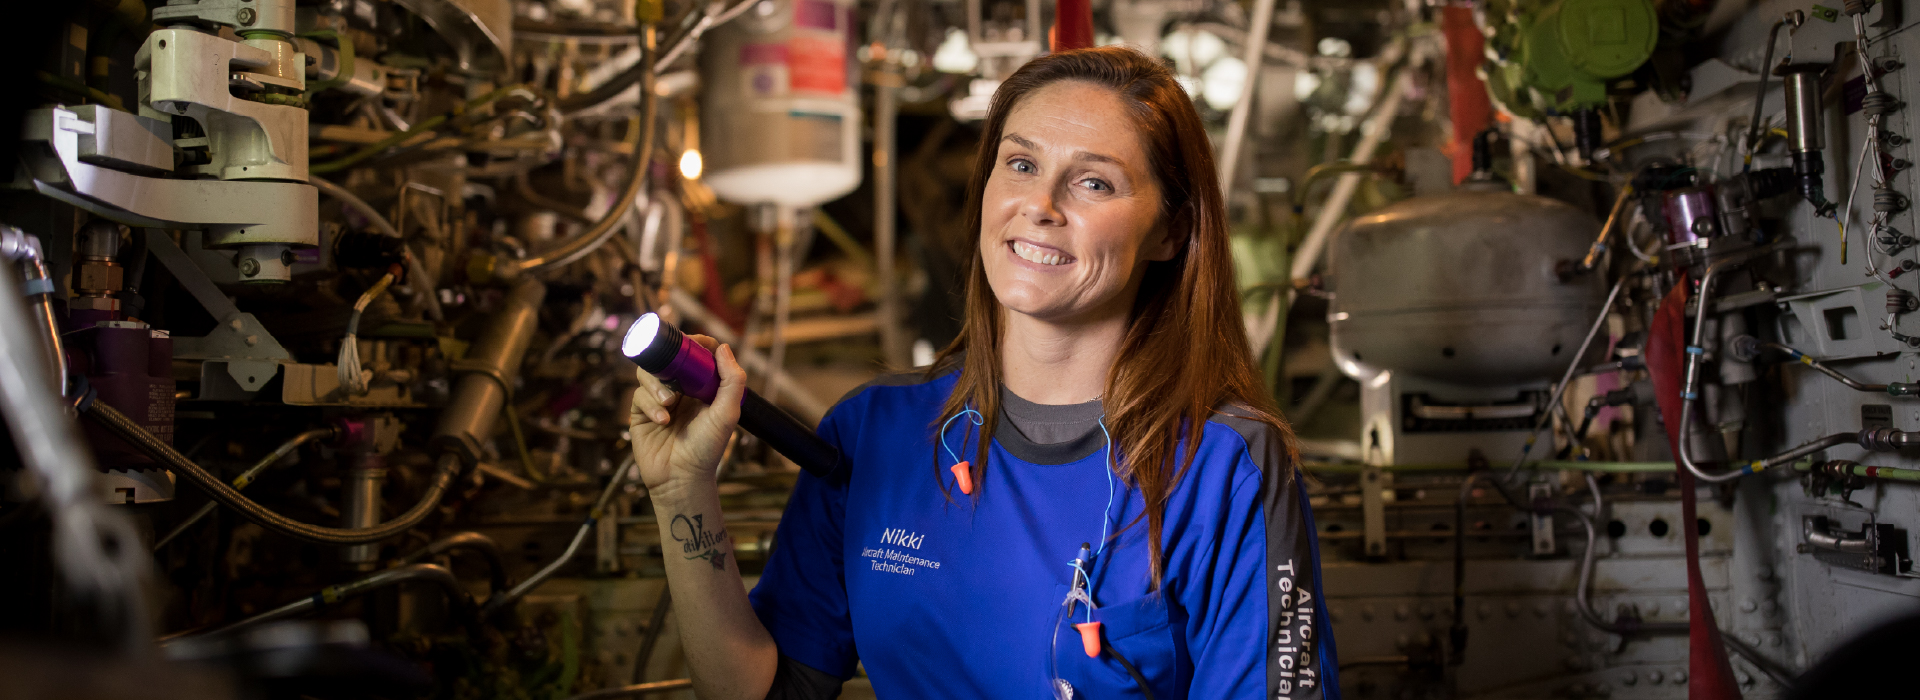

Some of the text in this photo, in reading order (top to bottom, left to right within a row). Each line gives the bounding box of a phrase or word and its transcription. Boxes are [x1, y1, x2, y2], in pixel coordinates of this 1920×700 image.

[880, 527, 925, 550] Nikki
[871, 559, 915, 576] Technician
[884, 548, 941, 570] Maintenance
[1277, 558, 1297, 700] Technicia
[1296, 587, 1316, 689] Aircraft
